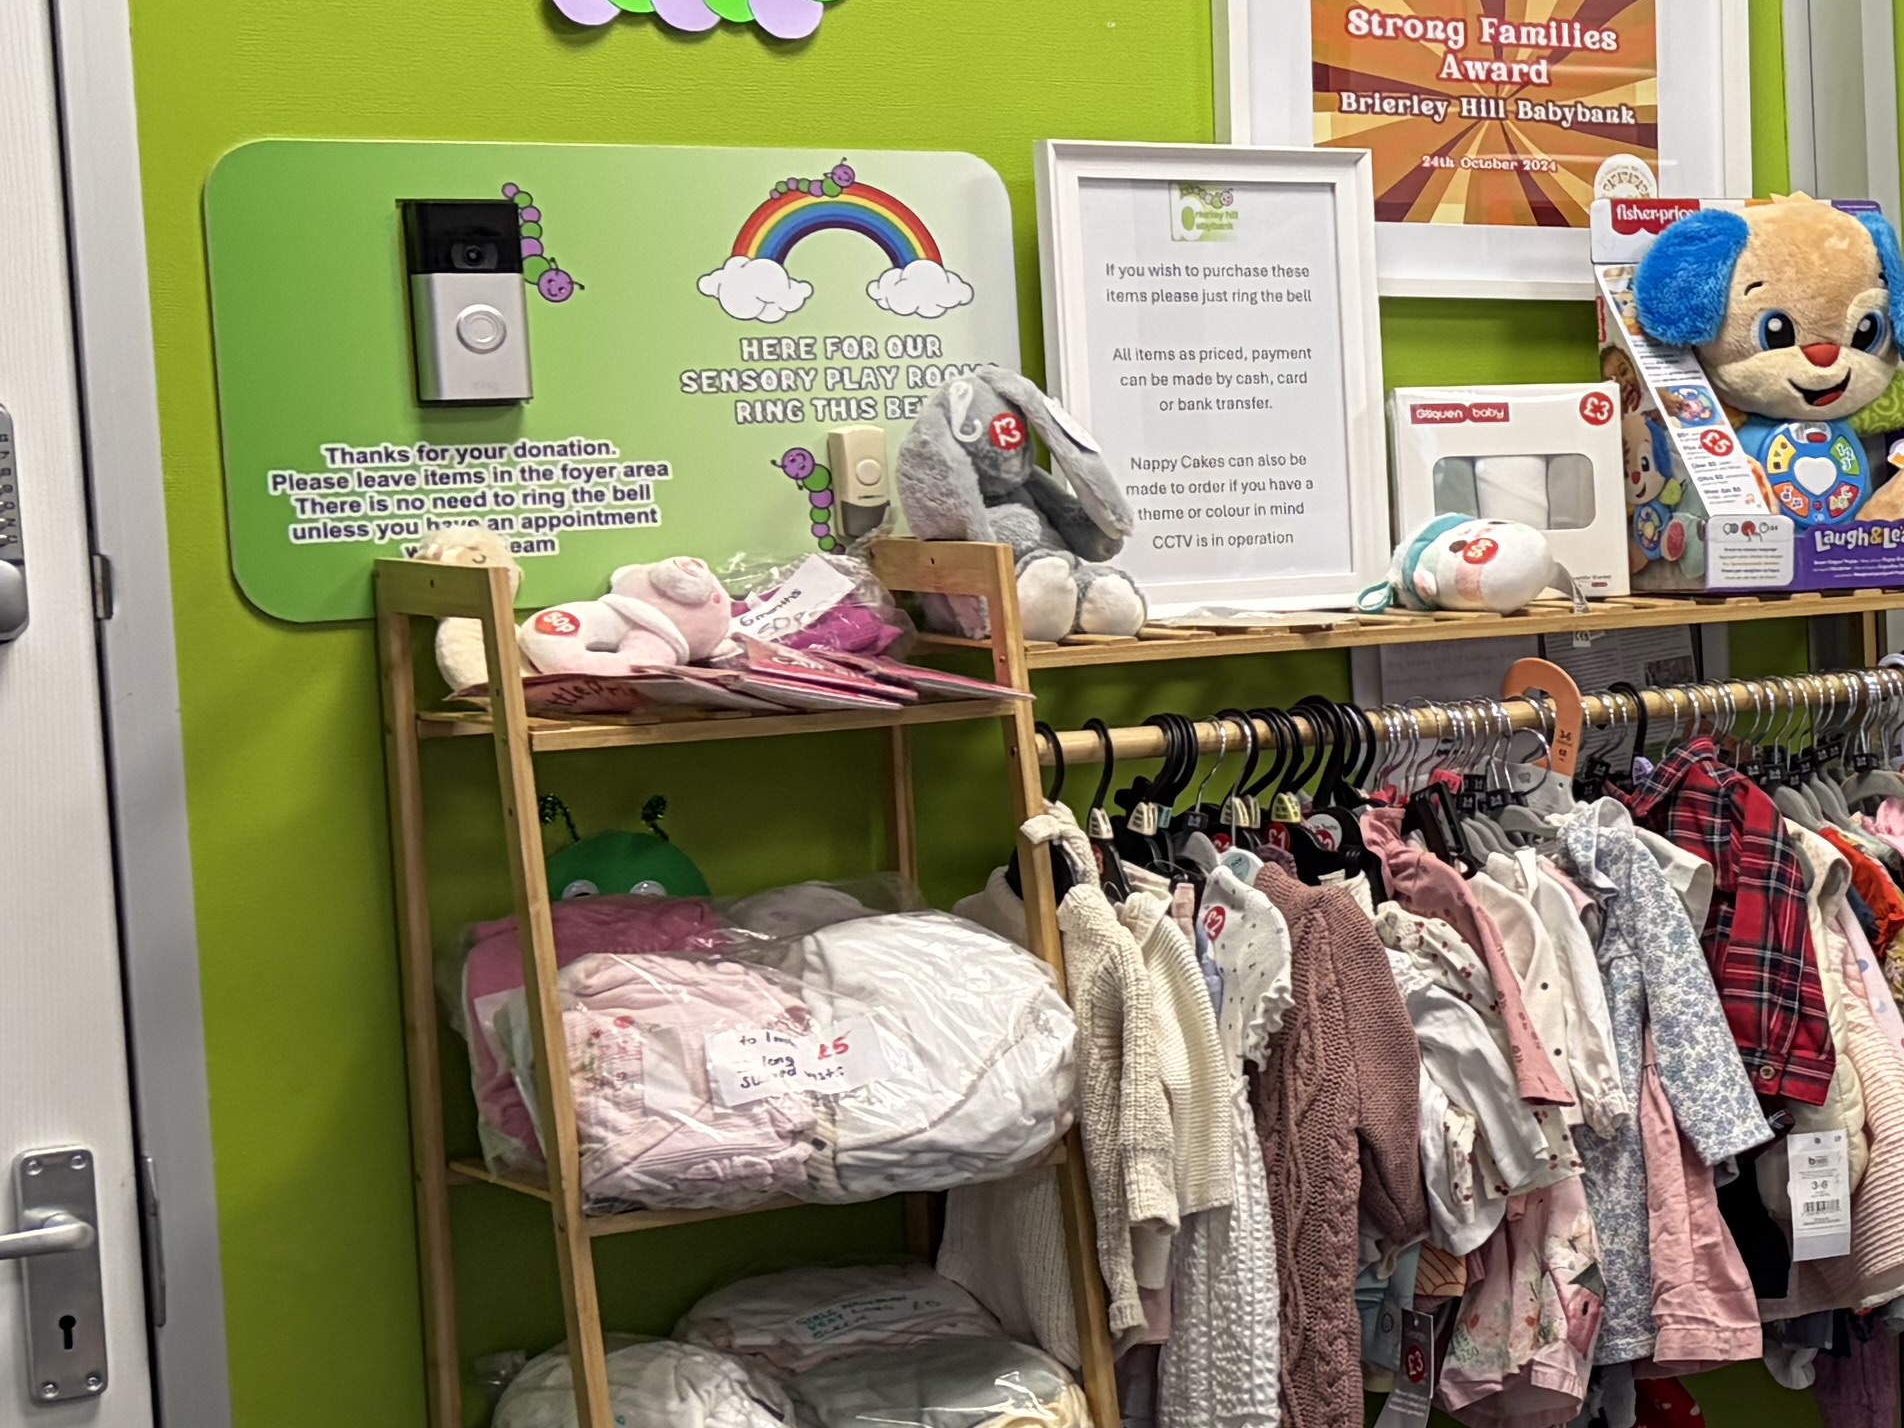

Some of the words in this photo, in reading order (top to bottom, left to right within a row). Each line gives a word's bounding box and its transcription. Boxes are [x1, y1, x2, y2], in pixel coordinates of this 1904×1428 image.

[1346, 7, 1466, 49] Strong
[1480, 17, 1619, 52] Families
[1438, 54, 1551, 86] Award
[1339, 91, 1450, 122] Brierley
[1460, 96, 1508, 120] Hill
[1516, 98, 1636, 129] Babybank
[1421, 154, 1455, 168] 24th
[1460, 156, 1518, 172] October
[1522, 158, 1558, 172] 2024
[1106, 264, 1115, 276] If
[1118, 265, 1145, 279] you
[1149, 264, 1182, 276] wish
[1185, 264, 1199, 276] to
[1203, 264, 1268, 280] purchase
[1272, 264, 1310, 277] these
[1106, 290, 1147, 302] items
[1152, 289, 1198, 305] please
[1201, 290, 1227, 305] just
[1232, 289, 1258, 305] ring
[1261, 290, 1283, 302] the
[1287, 290, 1312, 302] bell
[739, 336, 817, 361] HERE
[825, 336, 878, 360] FOR
[885, 334, 942, 359] OUR
[680, 368, 816, 394] SENSORY
[824, 367, 900, 391] PLAY
[734, 400, 804, 424] RING
[811, 398, 878, 421] THIS
[1584, 397, 1610, 420] £3
[325, 446, 410, 464] Thanks
[418, 444, 449, 460] for
[455, 445, 507, 464] your
[514, 441, 617, 459] donation.
[271, 473, 349, 492] Please
[357, 471, 417, 489] leave
[424, 468, 486, 486] items
[492, 468, 512, 484] in
[520, 466, 554, 482] the
[560, 465, 617, 484] foyer
[623, 463, 670, 478] area
[1153, 535, 1193, 549] CCTV
[1197, 534, 1208, 547] is
[1212, 534, 1223, 546] in
[1228, 532, 1294, 548] operation
[540, 610, 576, 635] 50p
